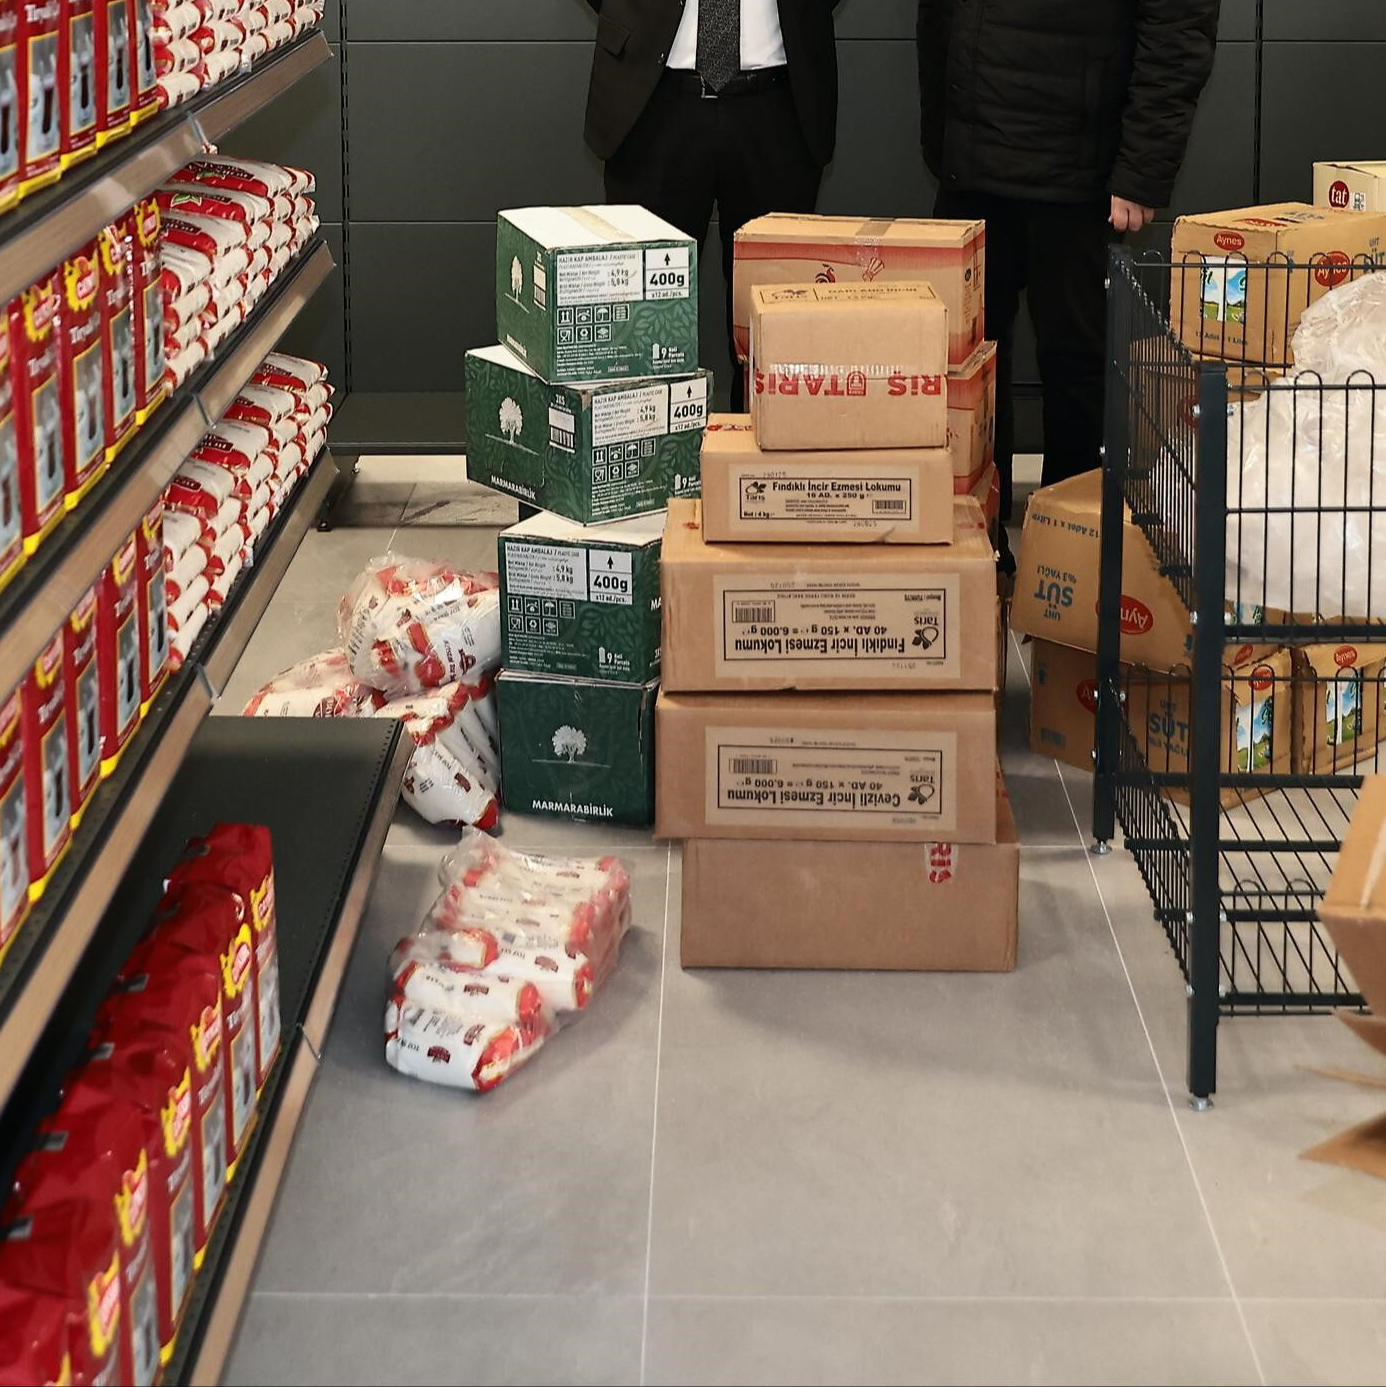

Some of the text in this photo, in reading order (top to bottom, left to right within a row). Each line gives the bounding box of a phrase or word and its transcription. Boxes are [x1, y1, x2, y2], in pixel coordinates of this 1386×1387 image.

[1330, 188, 1348, 205] tat
[1217, 235, 1242, 246] Aynes
[621, 269, 629, 277] kg
[650, 272, 685, 287] 400g
[661, 348, 666, 357] 9
[887, 371, 941, 396] RİŞ
[649, 405, 655, 413] kg
[674, 404, 703, 419] 400g
[649, 413, 655, 421] kg
[491, 474, 536, 500] MARMARABİRLİK
[682, 478, 687, 488] 9
[773, 479, 901, 492] Fındıklı İncir Ezmesi Lokumu
[1032, 514, 1051, 526] Litre
[1067, 523, 1087, 535] Adet
[556, 566, 573, 575] 4,9 kg
[1037, 565, 1061, 579] YAĞLI
[566, 576, 573, 584] kg
[593, 575, 628, 593] 400g
[1034, 579, 1074, 607] SÜT
[1120, 608, 1148, 628] Ayn
[750, 625, 757, 634] g
[760, 626, 789, 635] 6.000
[811, 625, 818, 633] g
[820, 626, 839, 635] 150
[853, 626, 871, 635] AD.
[874, 626, 887, 634] 40
[735, 638, 905, 657] Fındıklı İncir Ezmesi Lokumu
[745, 777, 752, 786] g
[754, 779, 784, 788] 6.000
[806, 778, 812, 786] g
[815, 780, 834, 788] 150
[848, 781, 867, 789] AD.
[870, 781, 882, 789] 40
[727, 789, 901, 809] Cevizli İncir Ezmesi Lokumu
[532, 800, 613, 817] MARMARABİRLİK
